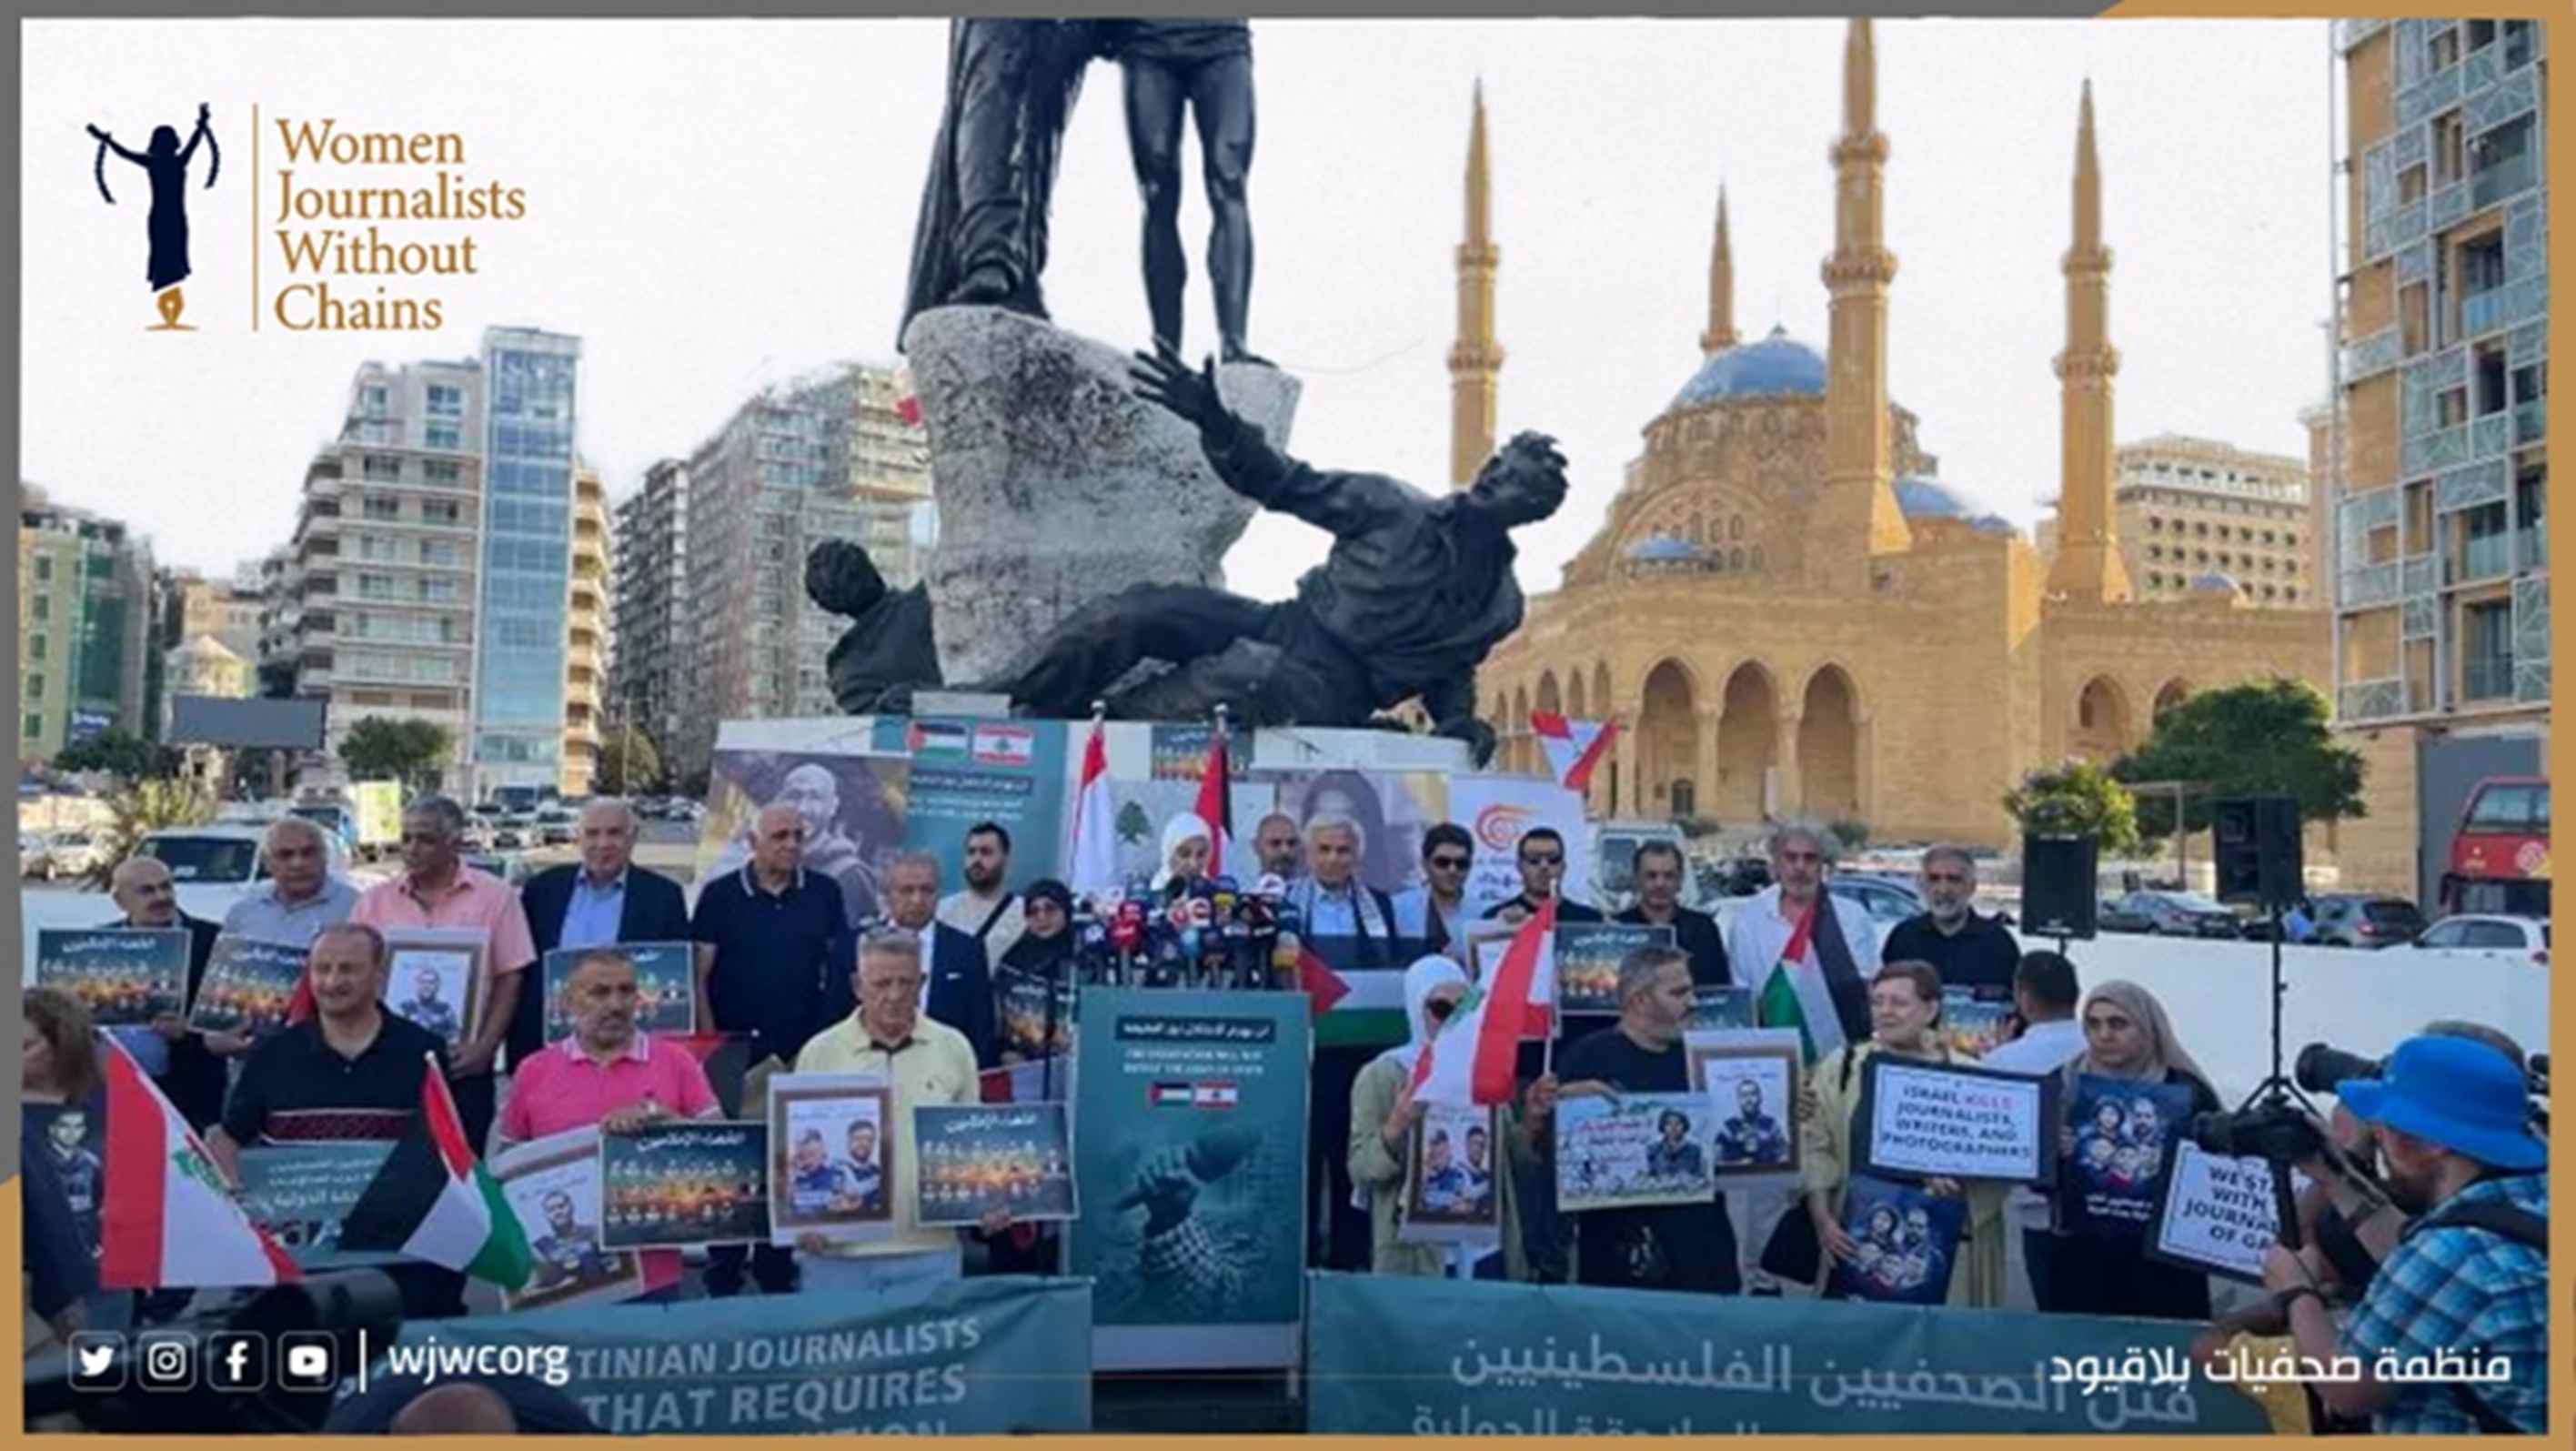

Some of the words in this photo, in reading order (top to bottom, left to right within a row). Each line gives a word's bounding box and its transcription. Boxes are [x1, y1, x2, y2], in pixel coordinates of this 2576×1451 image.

[1903, 1084, 1959, 1105] ISRAEL
[1882, 1134, 2030, 1157] PHOTOGRAPHERS
[1978, 1128, 2018, 1143] AND
[2211, 1187, 2267, 1212] WITH
[2183, 1199, 2279, 1234] JOURNA
[2209, 1225, 2236, 1243] OF
[576, 1341, 717, 1380] TINIAN
[729, 1317, 981, 1372] JOURNALISTS
[1453, 1332, 1792, 1392] الفلسطينيين
[580, 1387, 717, 1435] THAT
[728, 1364, 966, 1425] REQUIRES
[1809, 1359, 2066, 1413] الصحفيين
